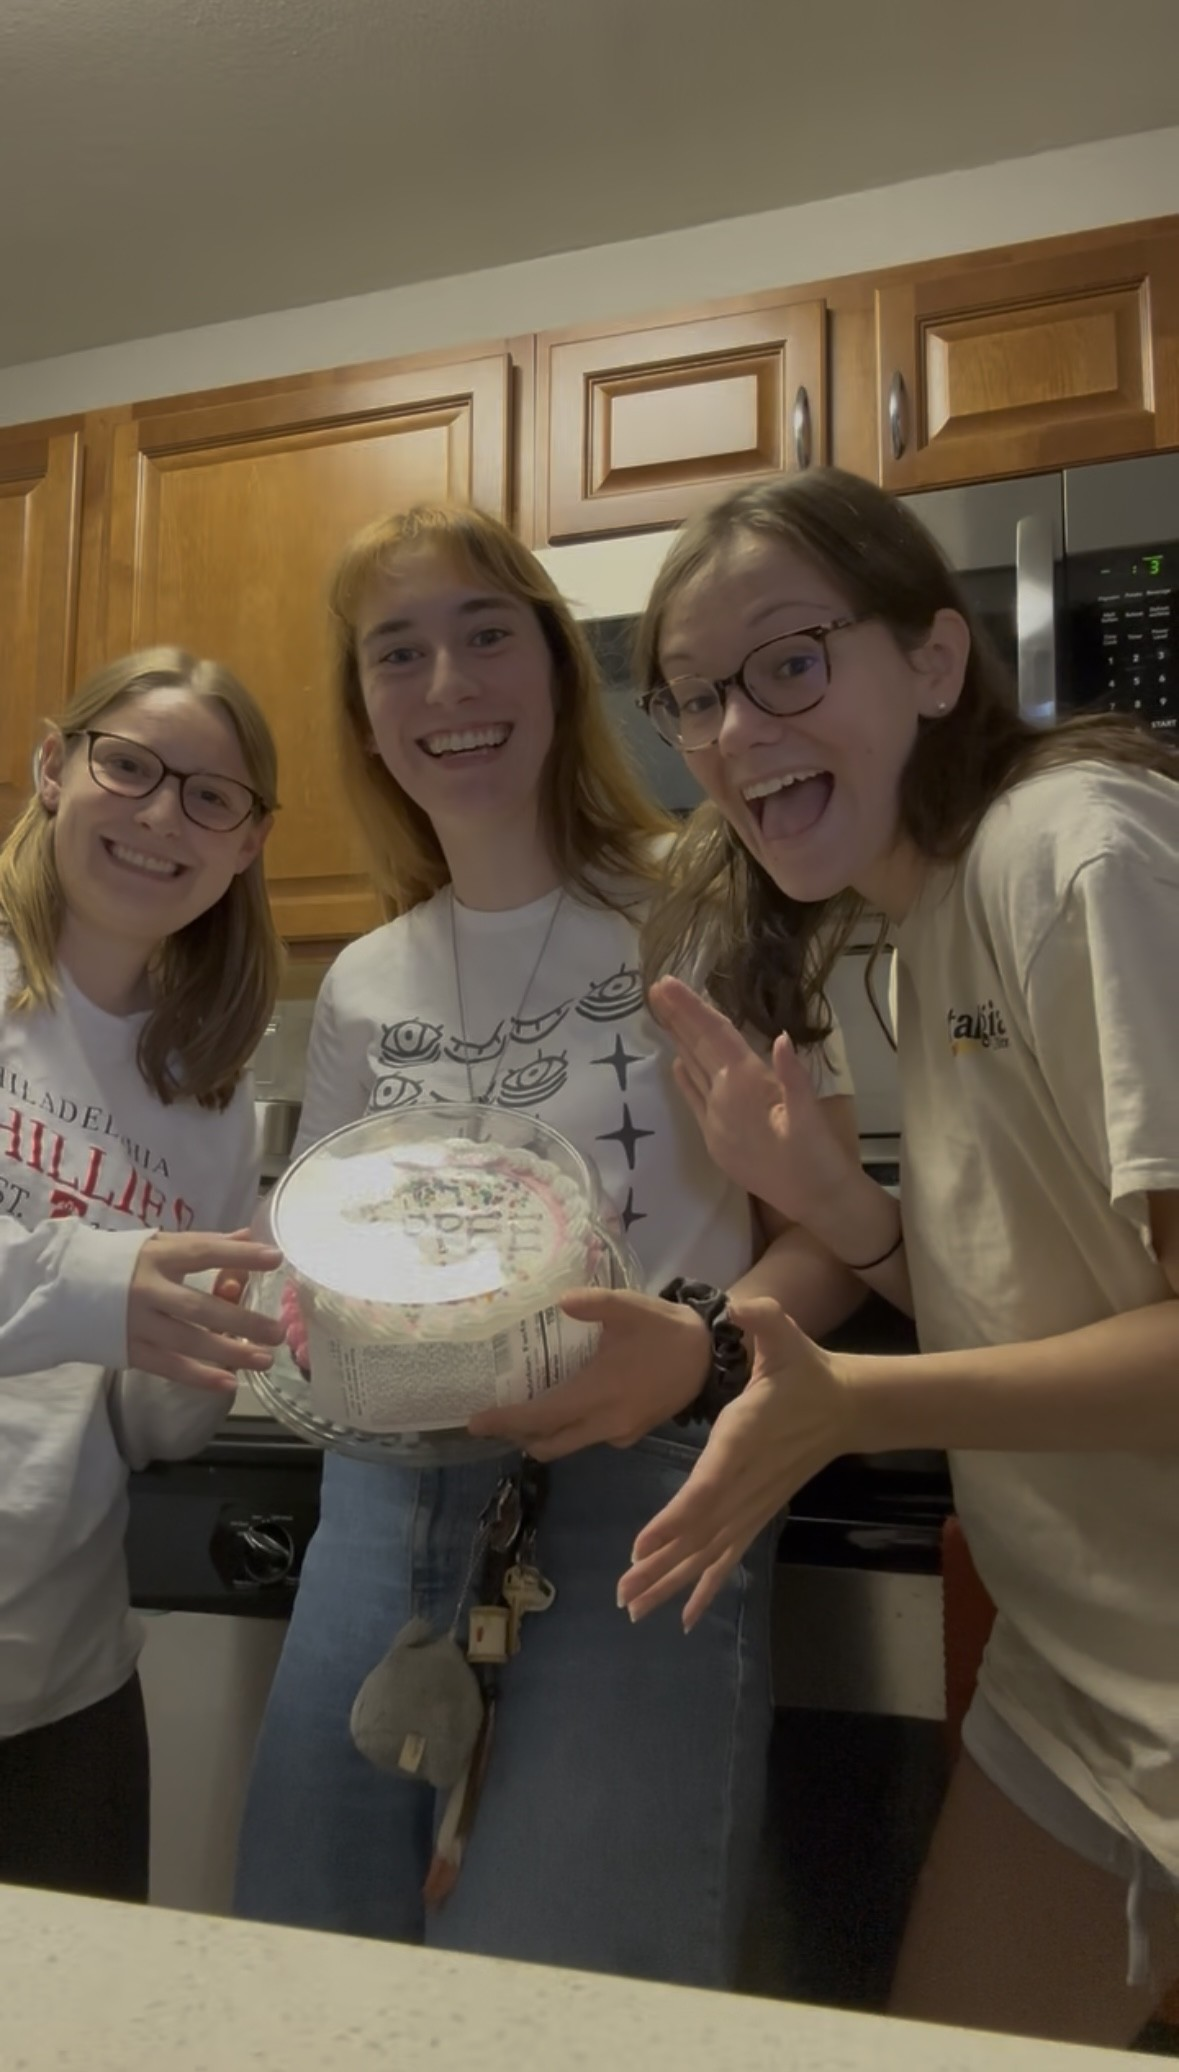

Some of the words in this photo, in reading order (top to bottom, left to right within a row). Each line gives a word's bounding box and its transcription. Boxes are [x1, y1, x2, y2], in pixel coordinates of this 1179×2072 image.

[1108, 656, 1114, 666] 1
[1132, 653, 1140, 663] 2
[1157, 651, 1165, 660] 3
[1108, 679, 1116, 688] 4
[1133, 676, 1141, 686] 5
[1151, 718, 1177, 729] START
